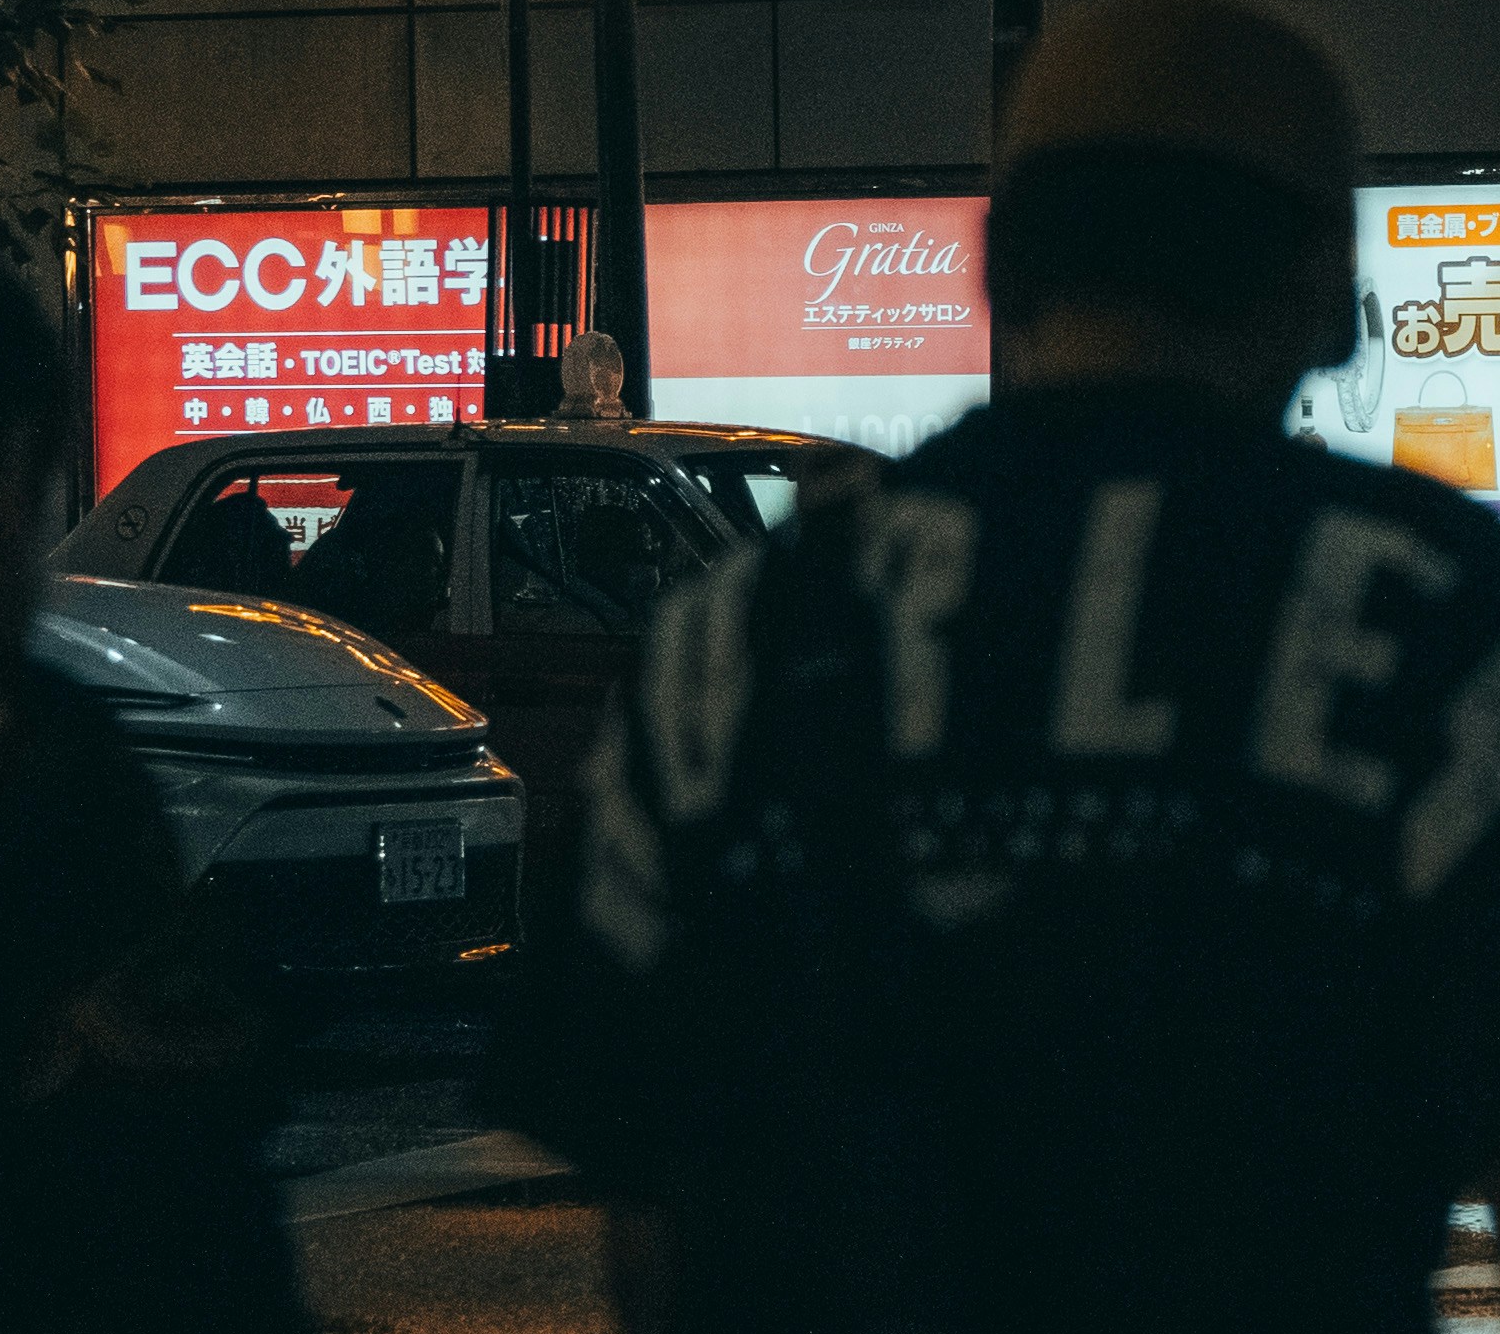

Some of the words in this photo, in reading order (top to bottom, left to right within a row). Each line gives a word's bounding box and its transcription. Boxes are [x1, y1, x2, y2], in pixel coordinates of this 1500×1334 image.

[869, 222, 905, 234] GINZA
[803, 304, 971, 324] エステティックサロン
[847, 337, 926, 350] 銀座グラティア
